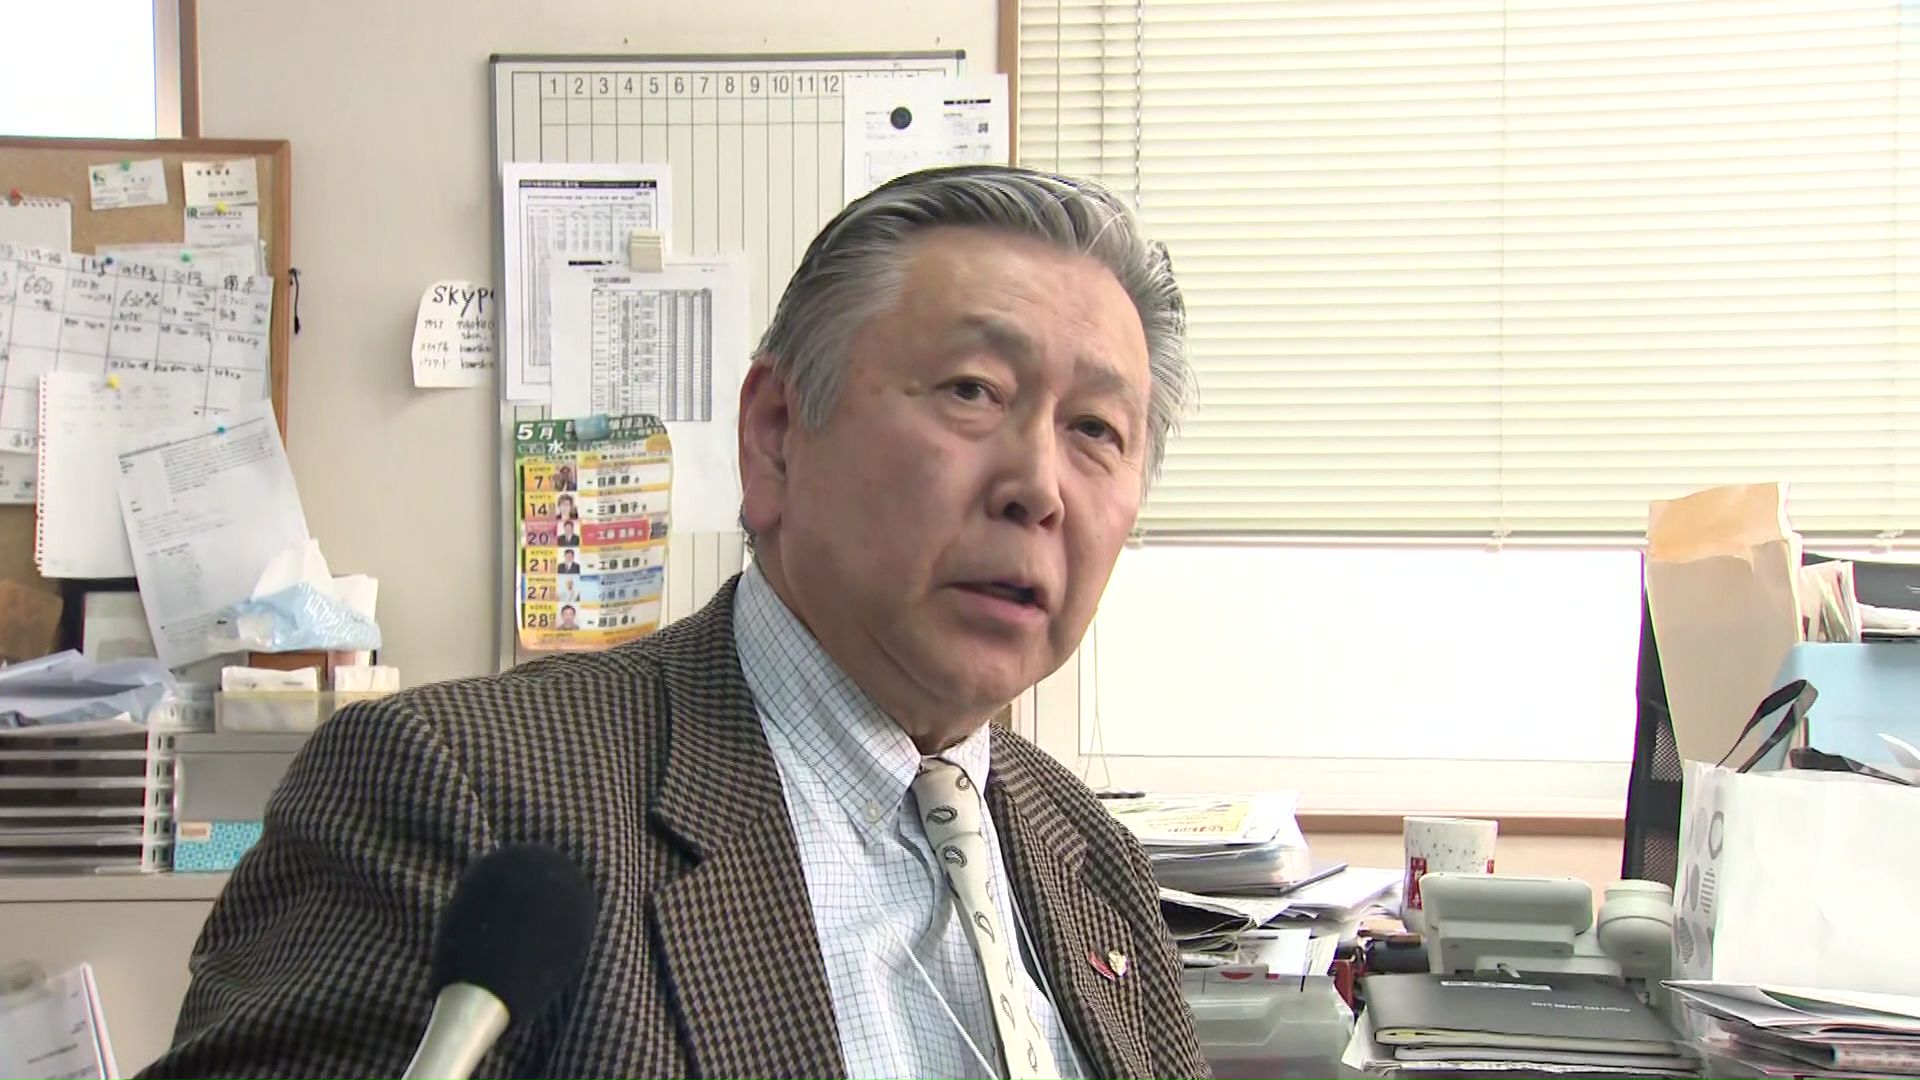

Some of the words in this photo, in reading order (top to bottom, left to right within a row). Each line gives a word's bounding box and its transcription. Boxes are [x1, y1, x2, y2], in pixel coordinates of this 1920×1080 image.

[574, 78, 584, 94] 2
[599, 78, 609, 94] 3
[624, 77, 634, 94] 4
[649, 77, 659, 94] 5
[674, 77, 684, 94] 6
[700, 77, 709, 94] 7
[725, 77, 735, 94] 8
[750, 76, 760, 94] 9
[773, 76, 789, 93] 10
[797, 76, 814, 93] 11
[823, 75, 839, 93] 12
[546, 439, 565, 454] 水
[534, 475, 544, 490] 7
[529, 503, 548, 517] 14
[527, 532, 549, 546] 20
[529, 558, 549, 573] 21
[527, 585, 548, 600] 27
[527, 613, 549, 628] 28
